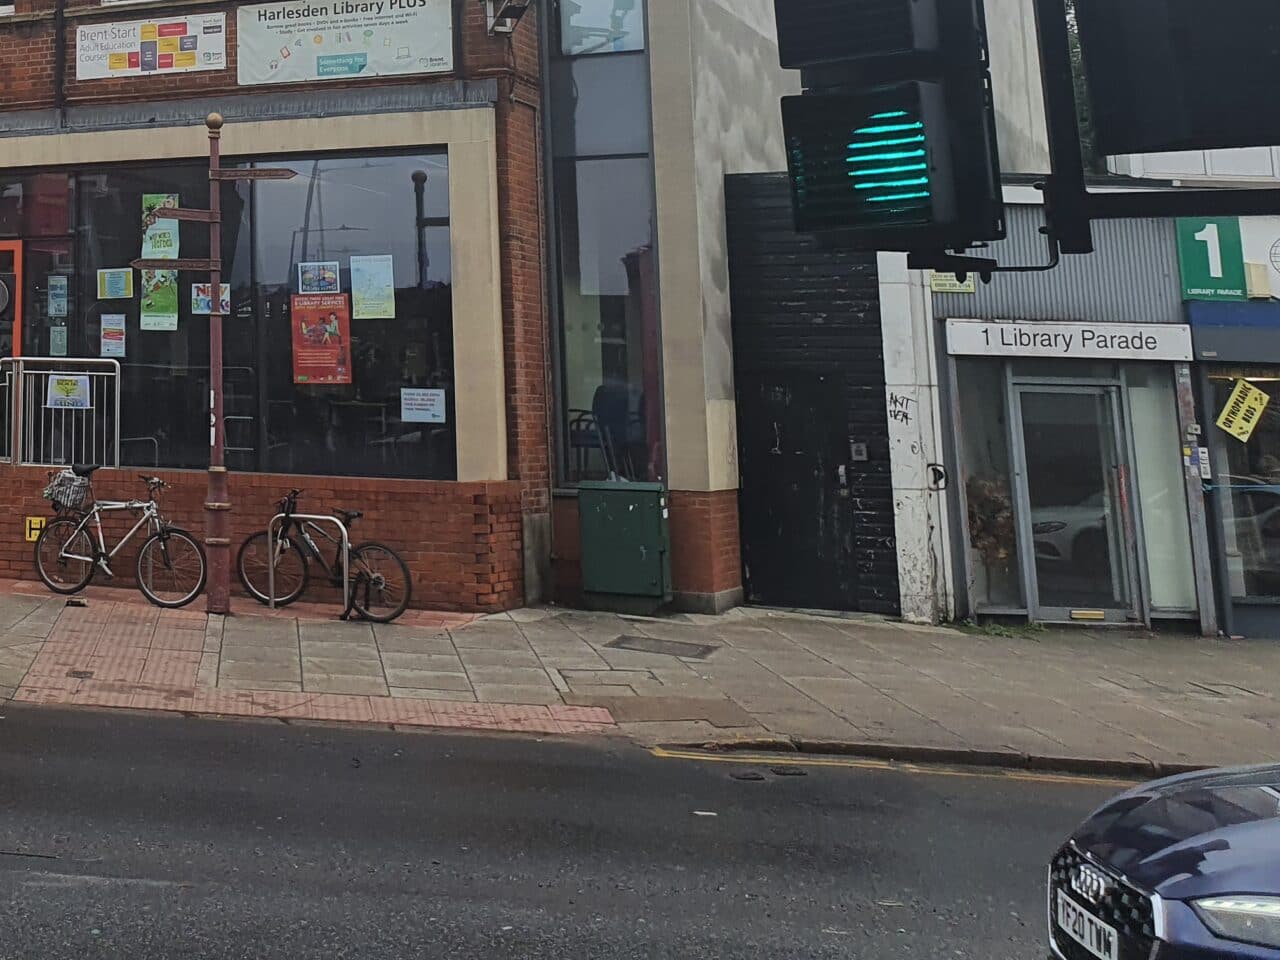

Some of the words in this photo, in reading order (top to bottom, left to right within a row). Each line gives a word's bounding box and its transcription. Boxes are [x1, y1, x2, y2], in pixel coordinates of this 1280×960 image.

[257, 5, 328, 22] Harlesden
[333, 0, 385, 16] Library
[80, 29, 108, 41] Brent
[111, 27, 136, 39] Start
[100, 41, 136, 51] Education
[1194, 223, 1223, 278] 1
[1187, 288, 1215, 296] LIBRARY
[981, 327, 990, 346] 1
[1000, 327, 1074, 353] Library
[1081, 329, 1158, 351] Parade
[1241, 405, 1257, 424] BEDS
[28, 519, 43, 539] H
